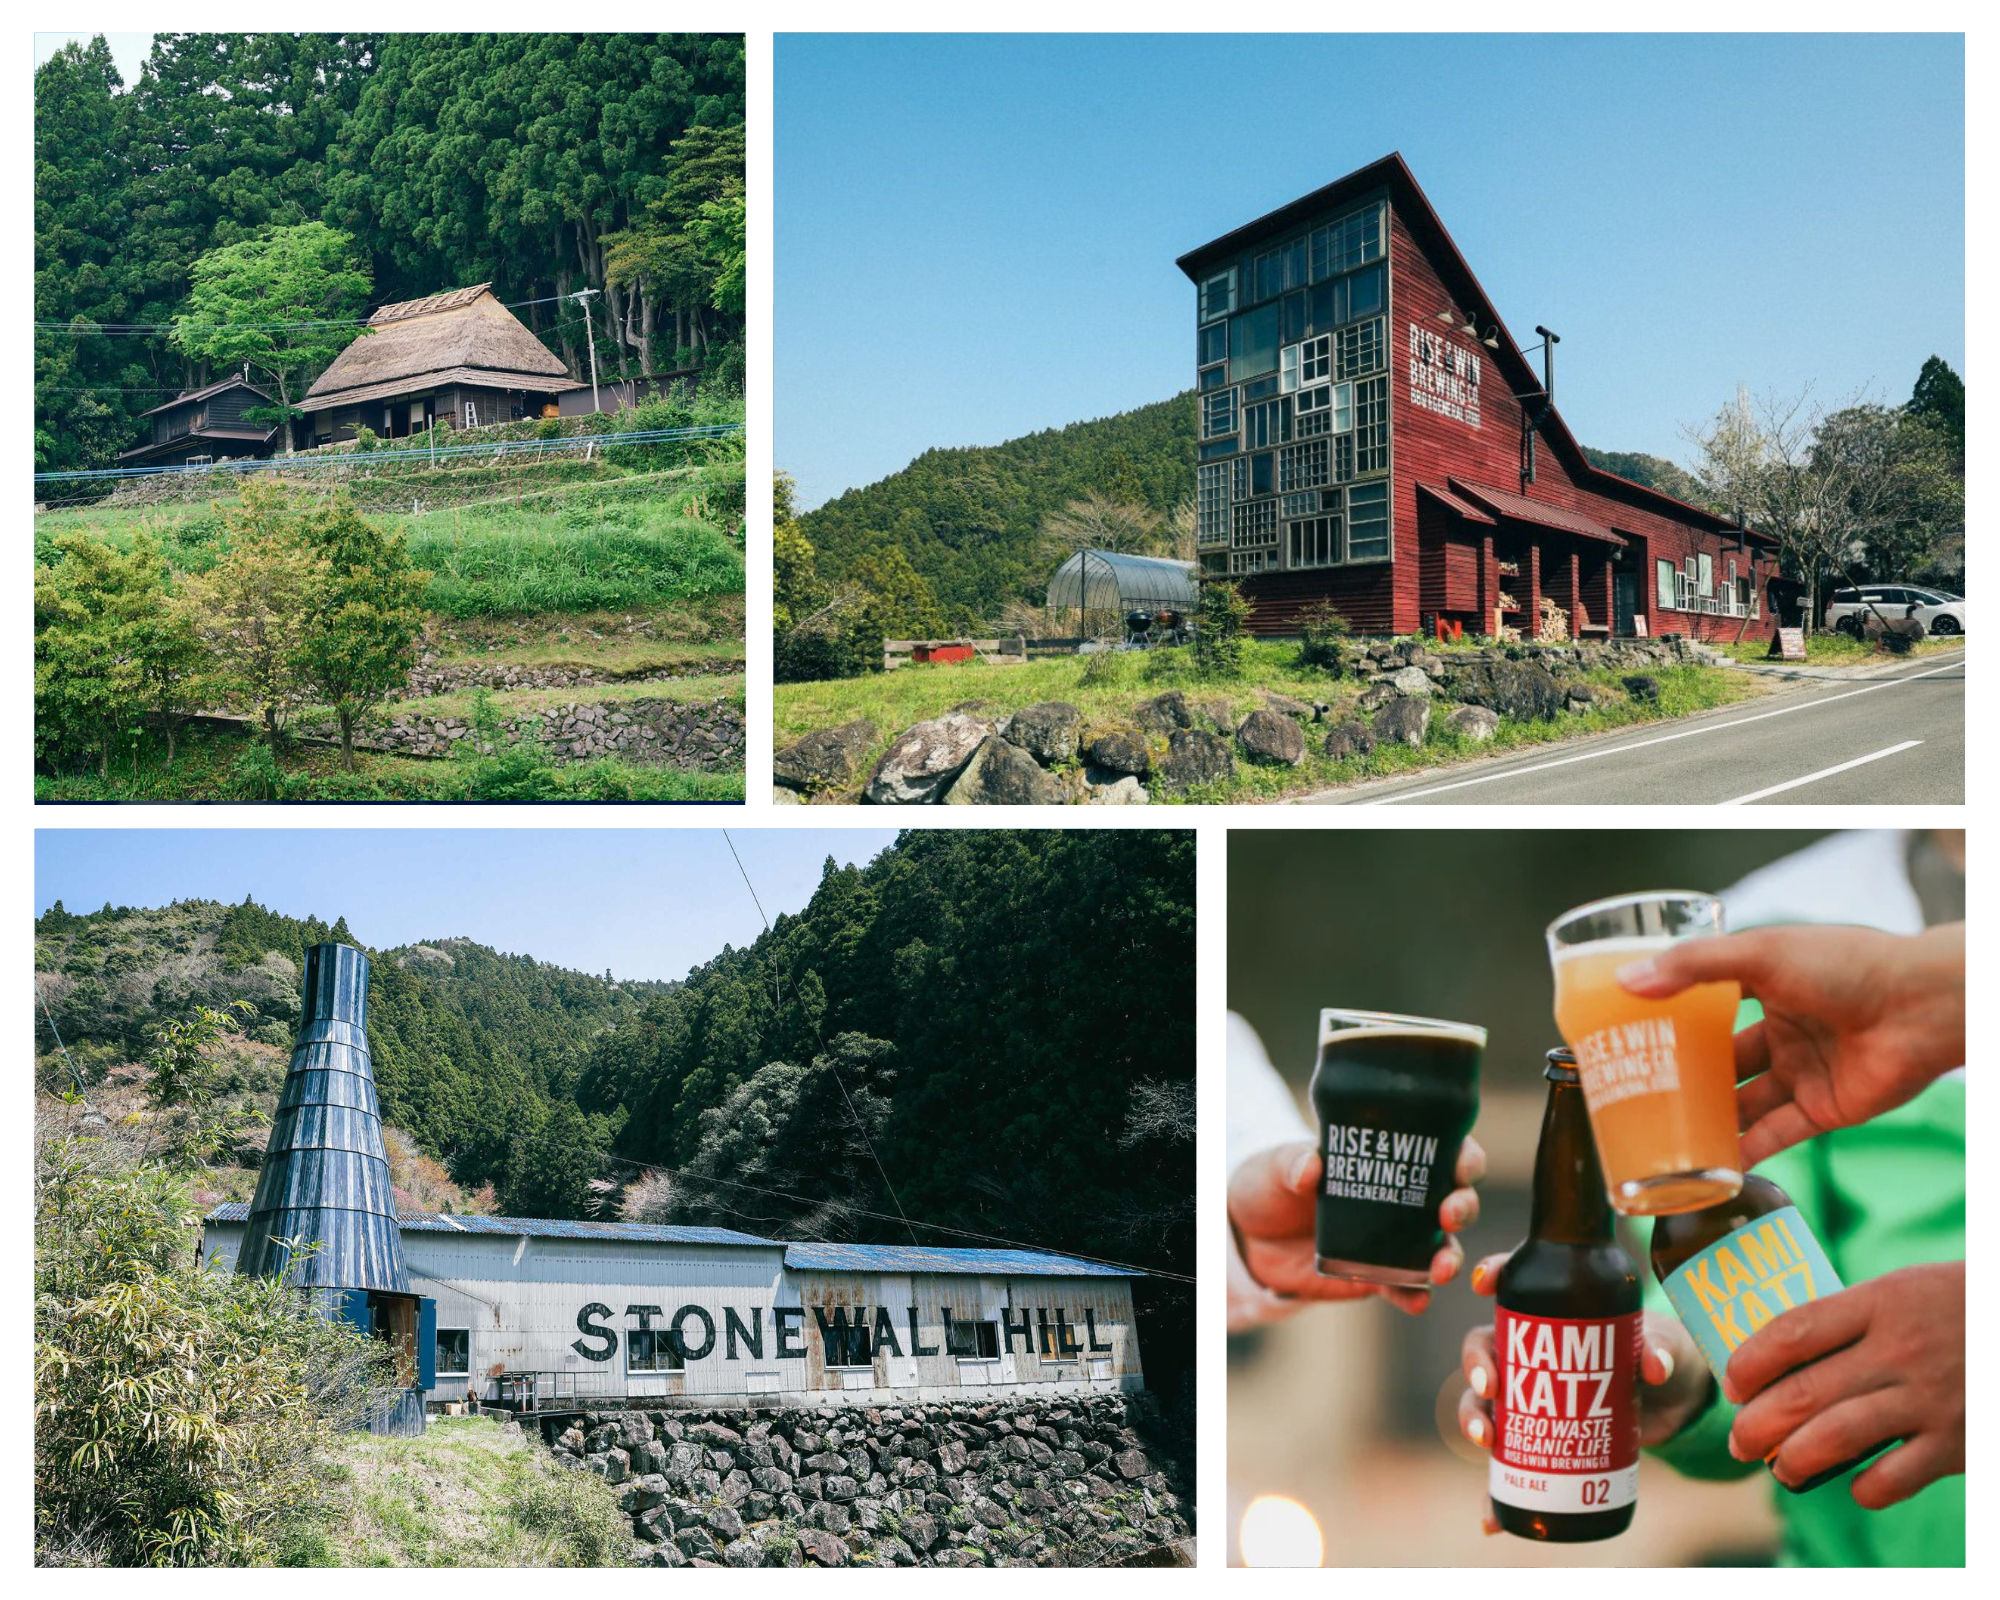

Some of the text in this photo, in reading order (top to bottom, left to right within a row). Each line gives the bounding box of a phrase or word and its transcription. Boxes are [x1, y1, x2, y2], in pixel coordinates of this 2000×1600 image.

[1409, 322, 1443, 368] RISE
[1454, 345, 1480, 385] WIN
[1410, 358, 1466, 405] BREWING
[1622, 1016, 1677, 1050] WIN
[1328, 1123, 1439, 1166] RISE & WIN
[1327, 1154, 1408, 1188] BREWING
[1684, 1216, 1806, 1314] KAMI
[569, 1302, 976, 1363] STONEWALL
[1000, 1306, 1113, 1355] HILL
[1507, 1316, 1616, 1372] KAMI
[1505, 1363, 1614, 1418] KATZ
[1504, 1411, 1614, 1440] ZERO WASTE
[1504, 1431, 1613, 1457] ORGANIC LIFE
[1550, 1456, 1599, 1470] BREWING
[1504, 1472, 1525, 1489] PALE
[1528, 1478, 1548, 1492] ALE
[1581, 1478, 1611, 1507] 02
